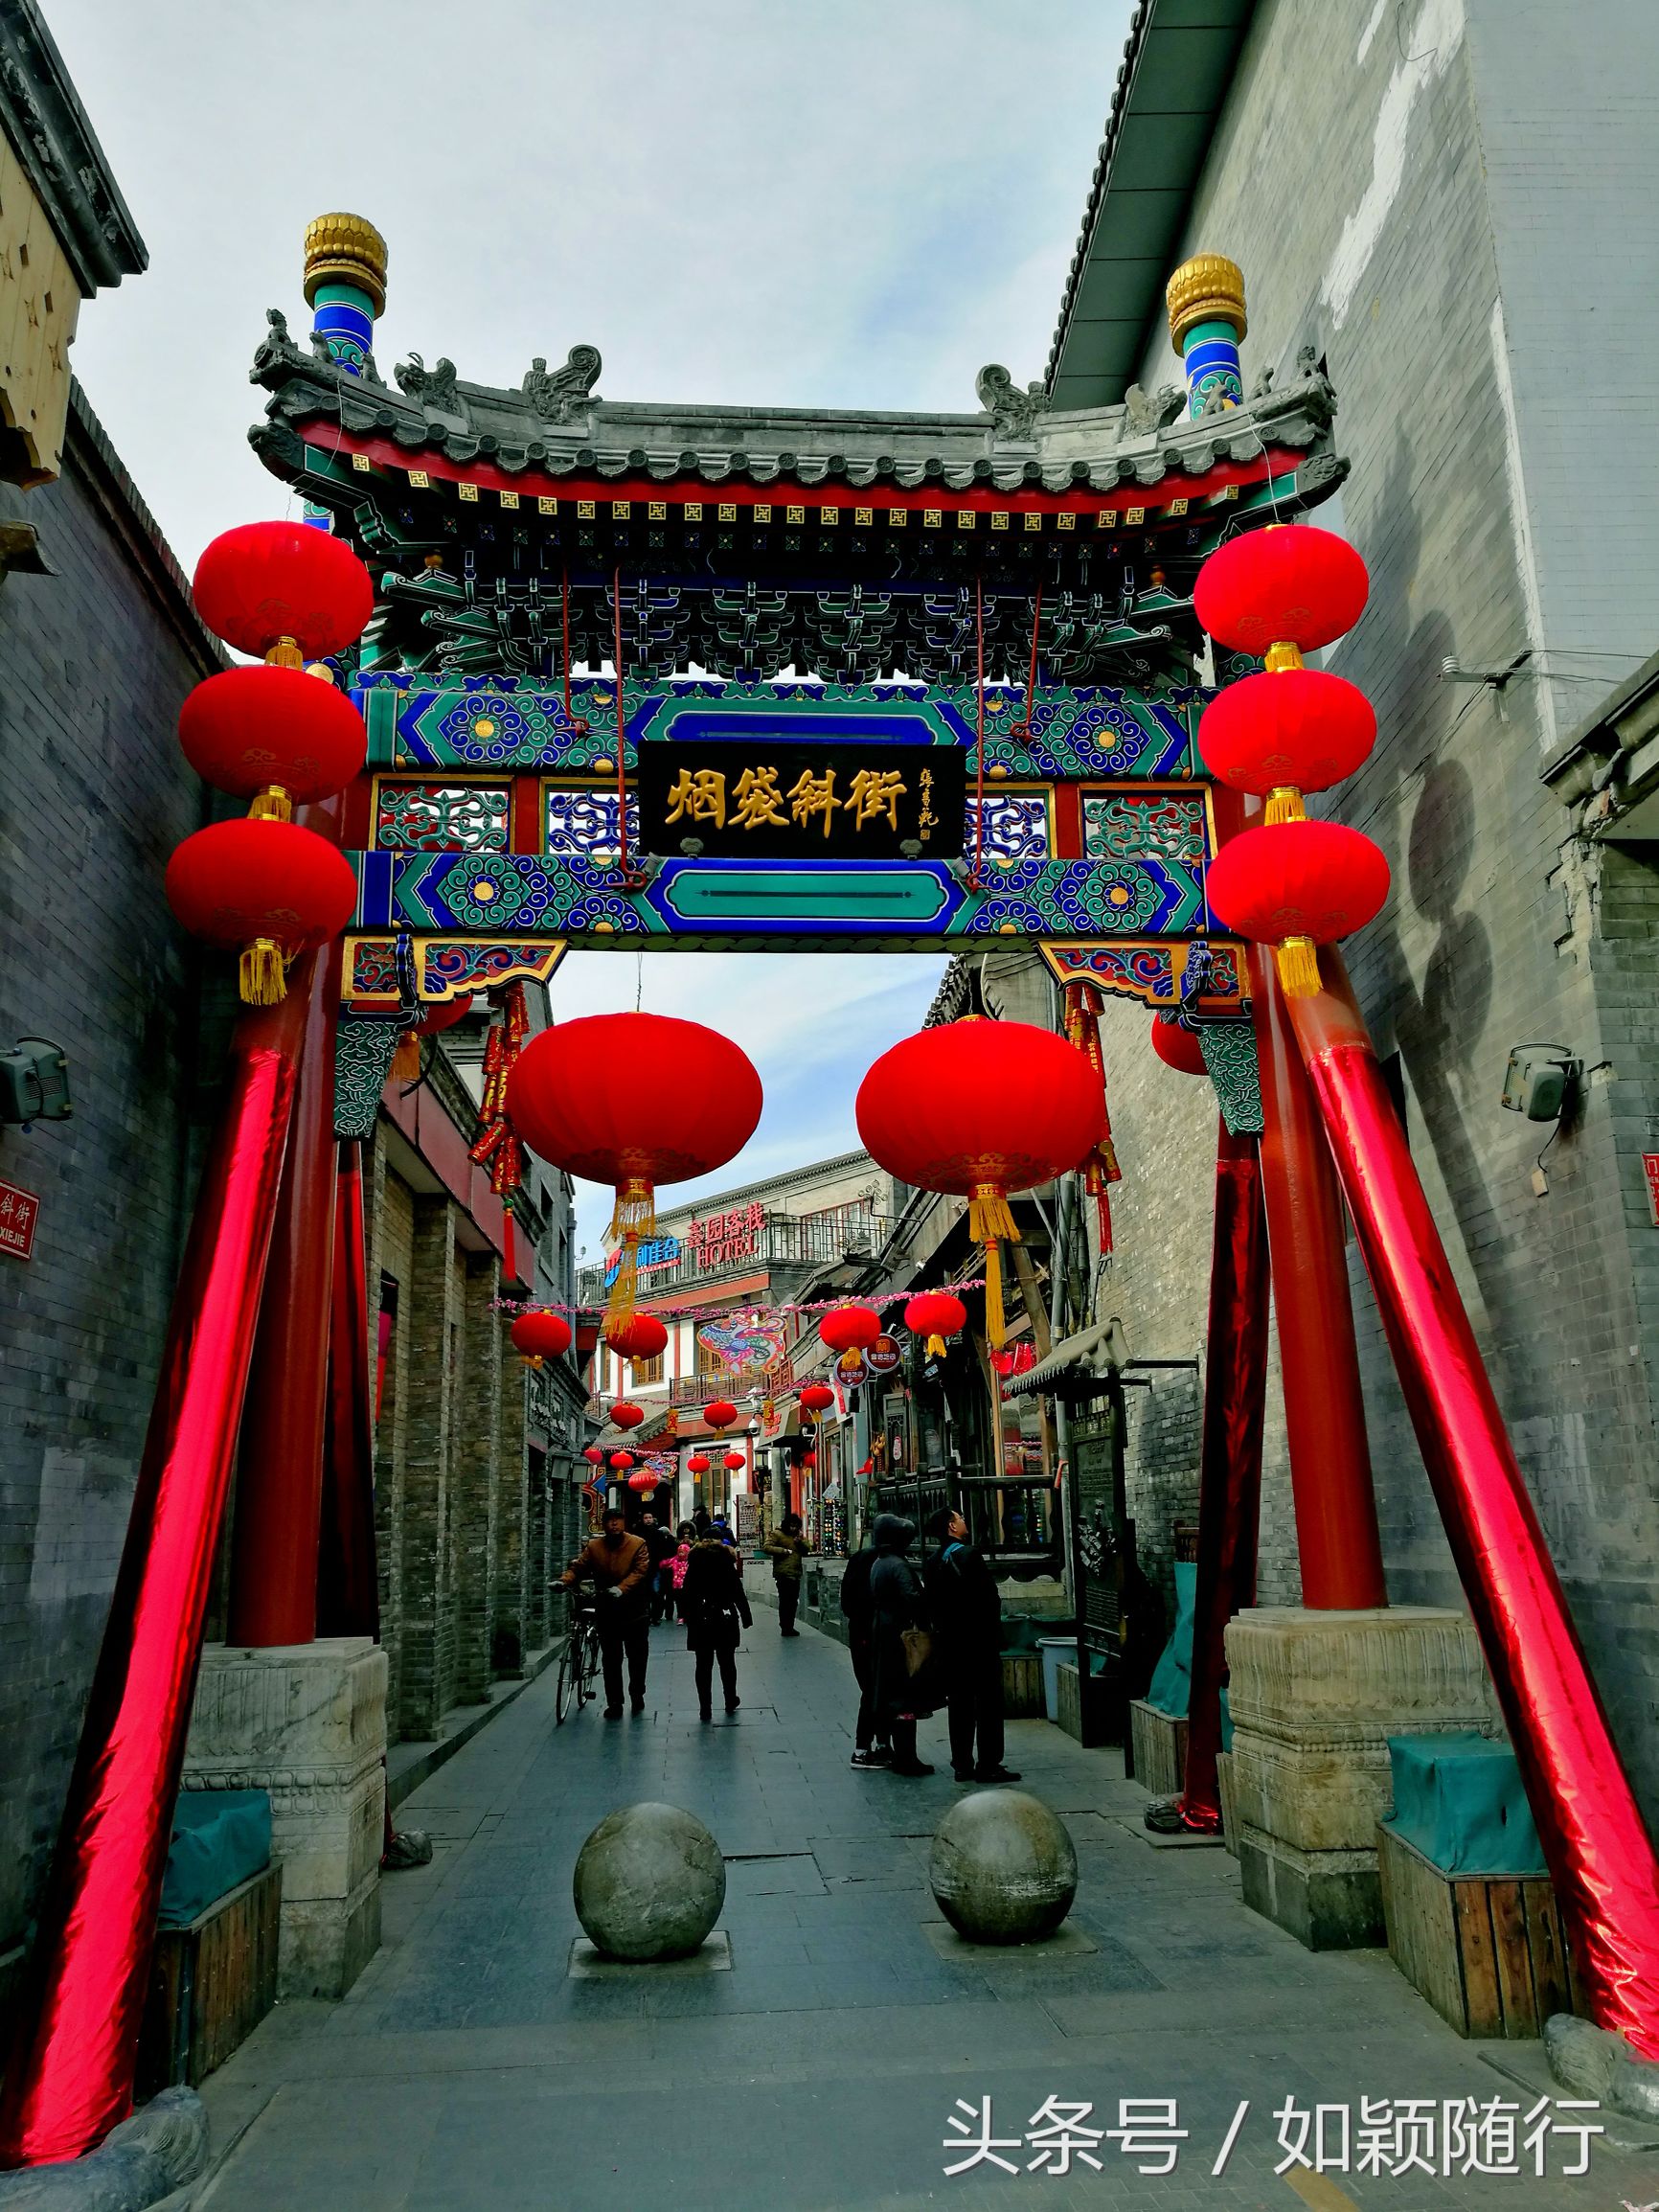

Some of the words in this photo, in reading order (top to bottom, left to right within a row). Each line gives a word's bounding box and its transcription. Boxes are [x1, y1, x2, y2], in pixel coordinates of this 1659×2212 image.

[665, 765, 908, 838] 烟袋斜街
[687, 1200, 766, 1248] 鑫园客栈
[696, 1234, 760, 1268] HOTEL
